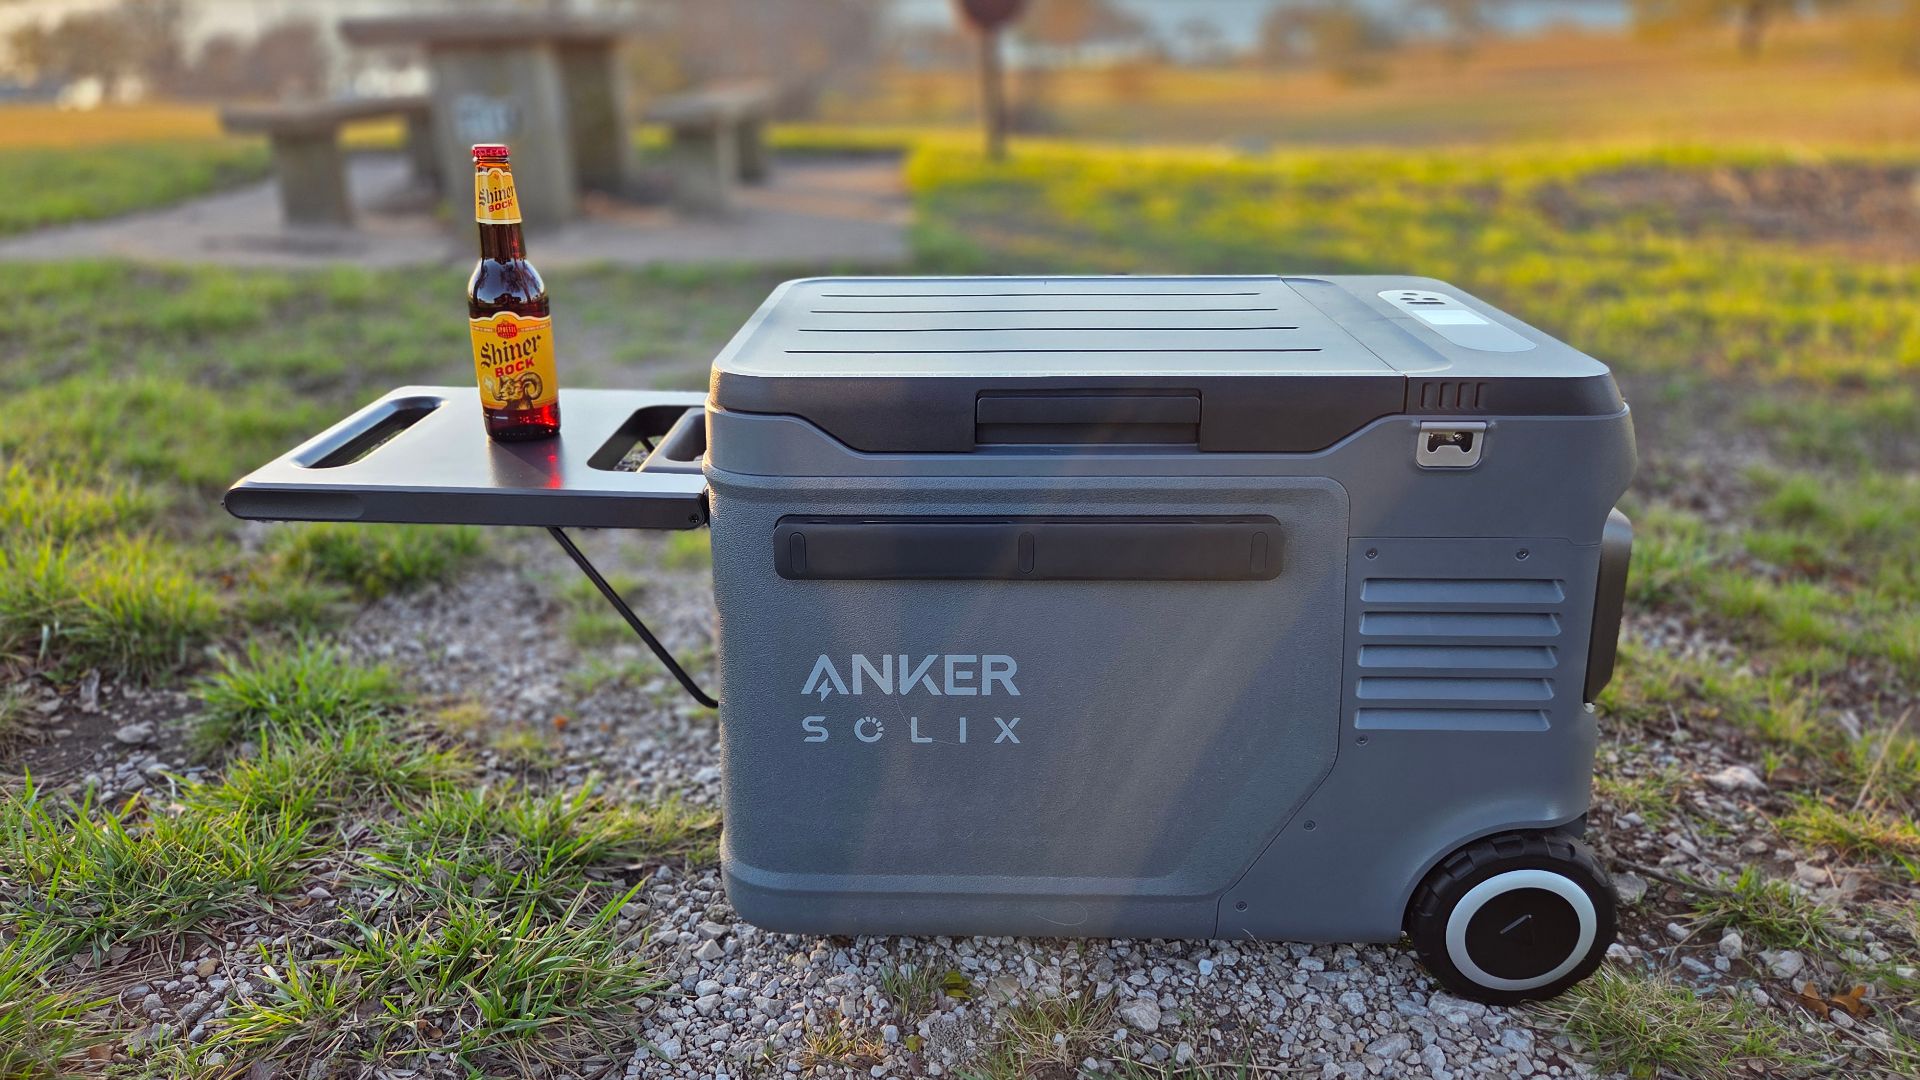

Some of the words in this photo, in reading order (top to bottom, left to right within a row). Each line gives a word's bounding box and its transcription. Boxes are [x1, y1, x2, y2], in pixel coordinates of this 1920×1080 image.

[489, 199, 513, 212] BOCK
[481, 334, 541, 368] Shiner
[495, 357, 535, 377] BOCK
[801, 654, 1021, 701] ANKER
[802, 716, 1021, 743] SOLIX
